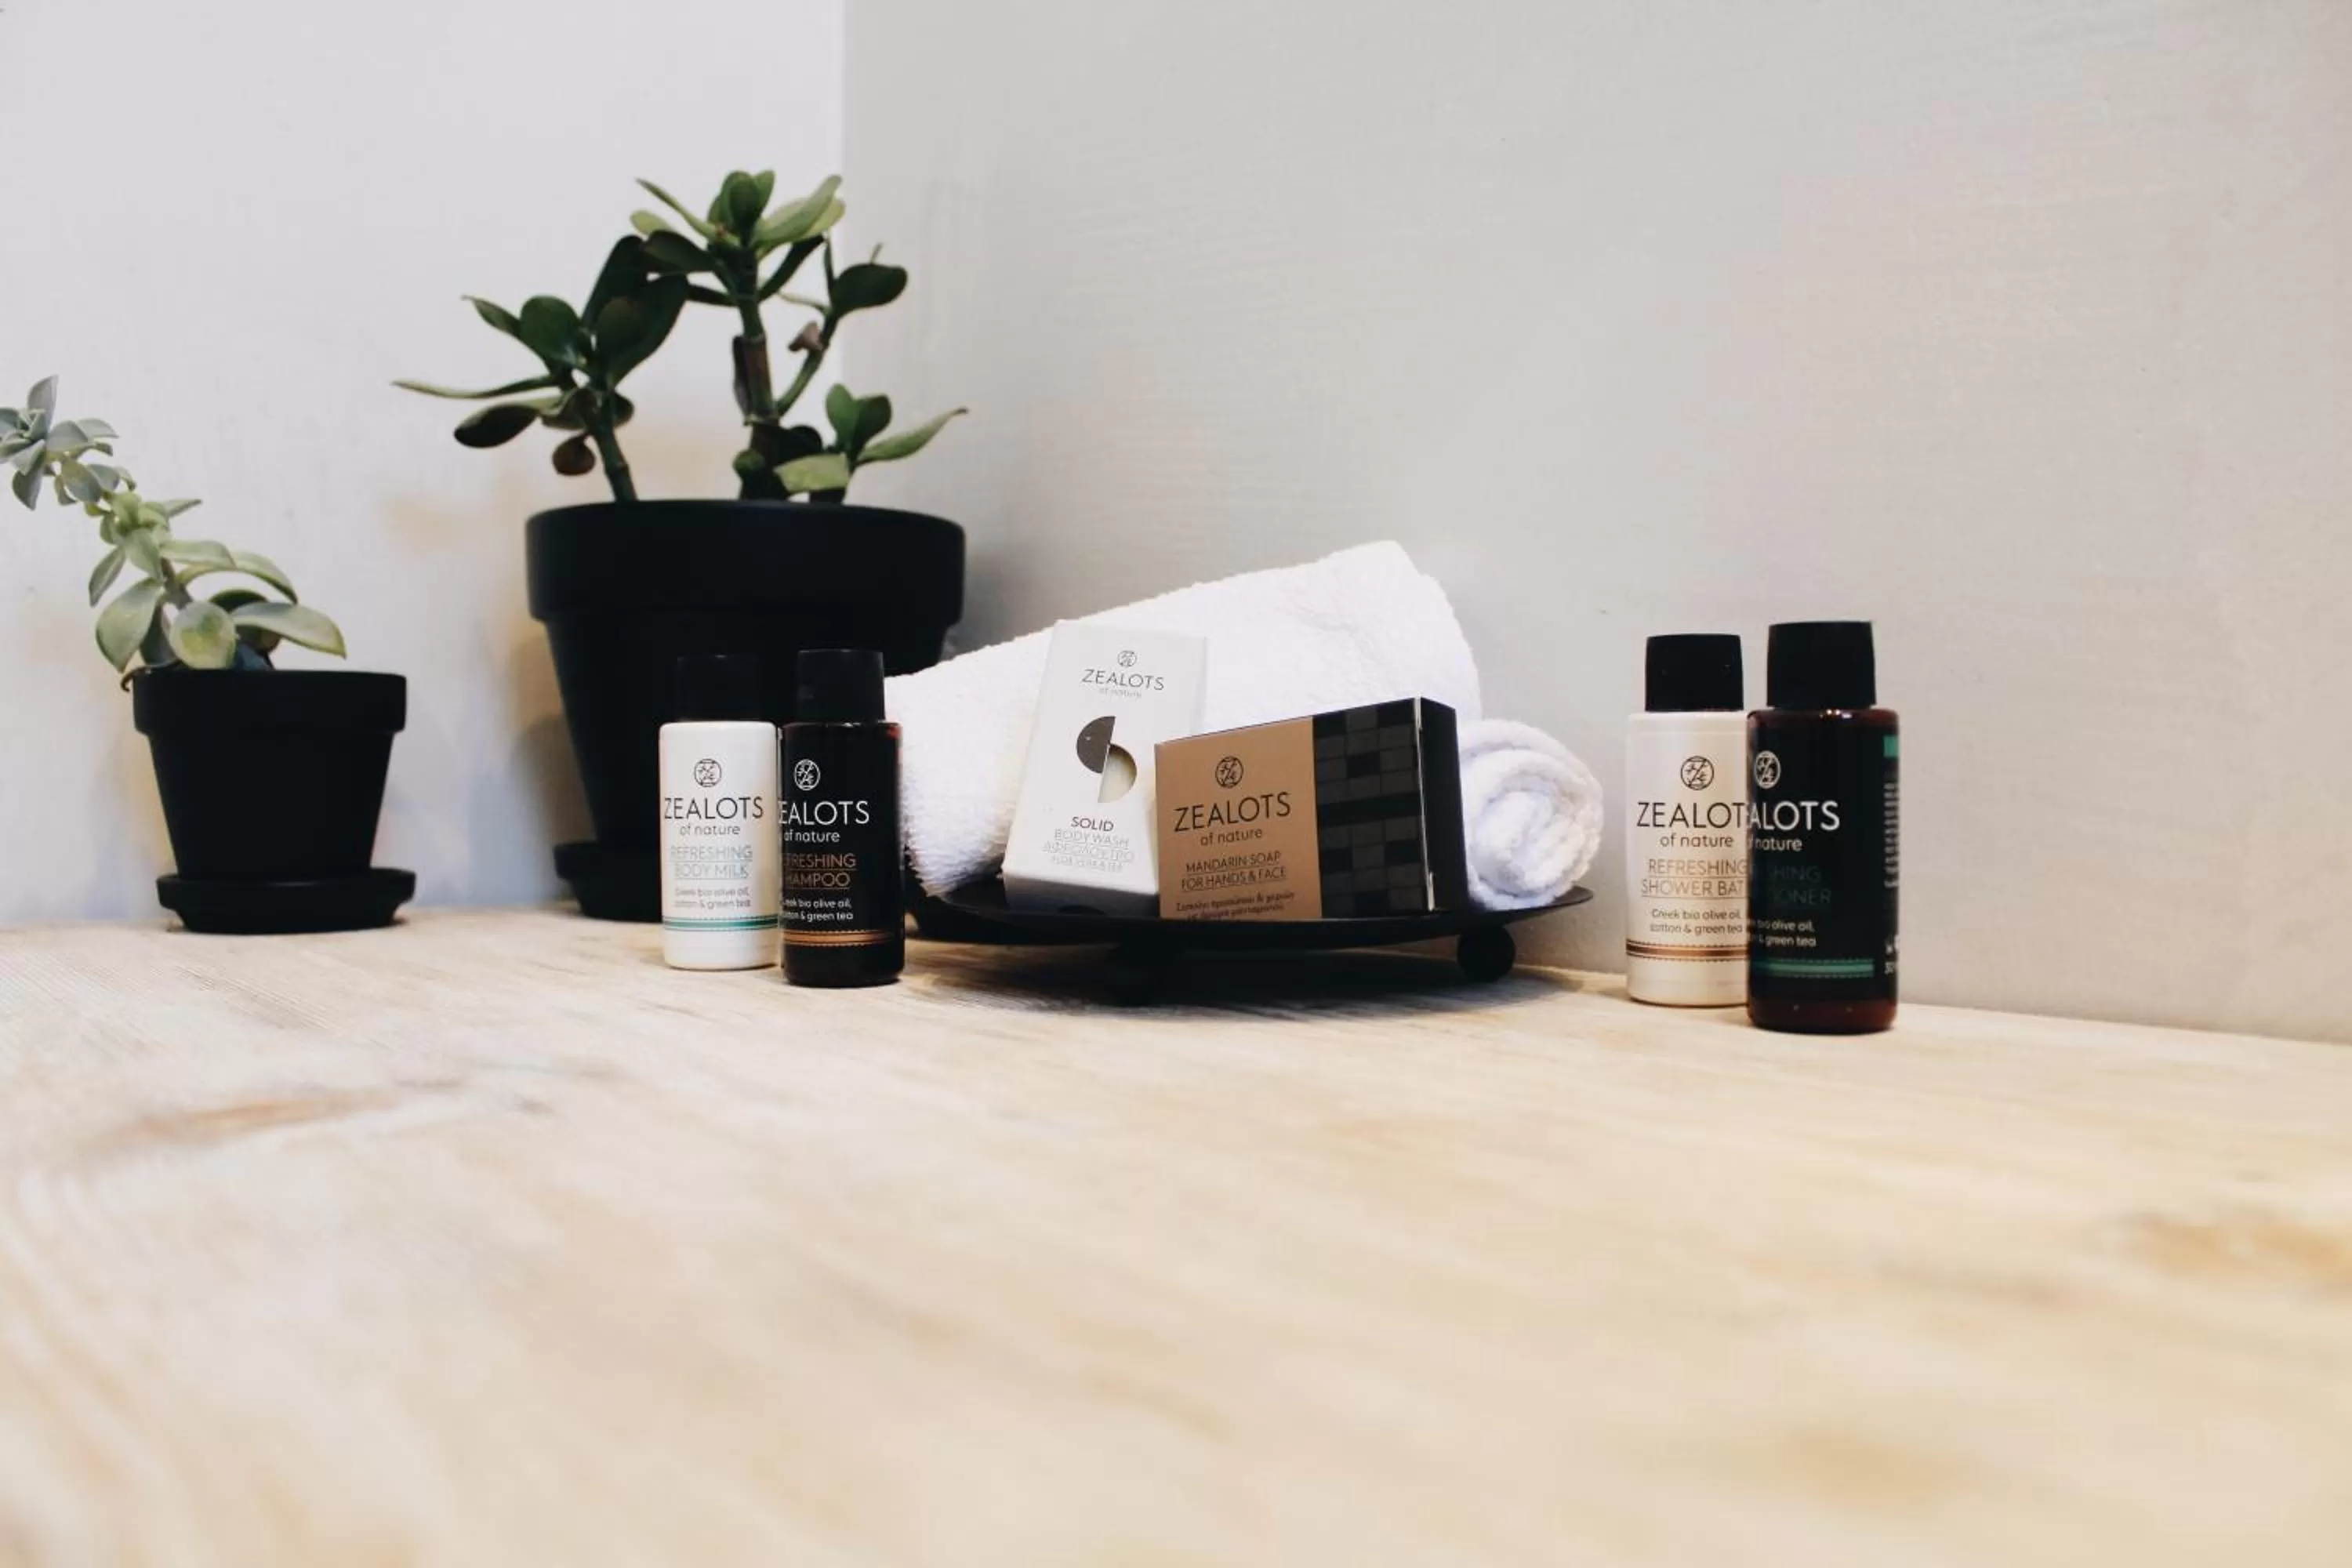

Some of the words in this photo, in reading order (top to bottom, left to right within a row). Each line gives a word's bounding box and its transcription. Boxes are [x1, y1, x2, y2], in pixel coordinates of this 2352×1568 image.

[1081, 669, 1165, 691] ZEALOTS
[664, 796, 764, 820] ZEALOTS
[778, 800, 870, 826] EALOTS
[1173, 791, 1292, 833] ZEALOTS
[1636, 800, 1745, 828] ZEALOT
[1748, 800, 1841, 831] ALOTS
[679, 825, 691, 835] of
[695, 825, 741, 836] nature
[1070, 816, 1114, 832] SOLID
[795, 831, 840, 844] nature
[1199, 832, 1215, 848] of
[1218, 827, 1264, 844] nature
[1660, 834, 1675, 848] of
[1679, 836, 1734, 848] nature
[1755, 838, 1803, 852] nature
[670, 844, 753, 860] REFRESHING
[1185, 855, 1247, 873] MANDARIN
[1250, 850, 1281, 866] SOAP
[1649, 858, 1748, 876] REFRESHING
[674, 864, 710, 877] BODY
[786, 871, 851, 887] HAMPOO
[1181, 875, 1204, 890] FOR
[1205, 872, 1246, 887] HANDS
[1258, 866, 1286, 880] FACE
[1641, 879, 1713, 896] SHOWER
[1718, 880, 1744, 896] BAT
[807, 912, 835, 923] green
